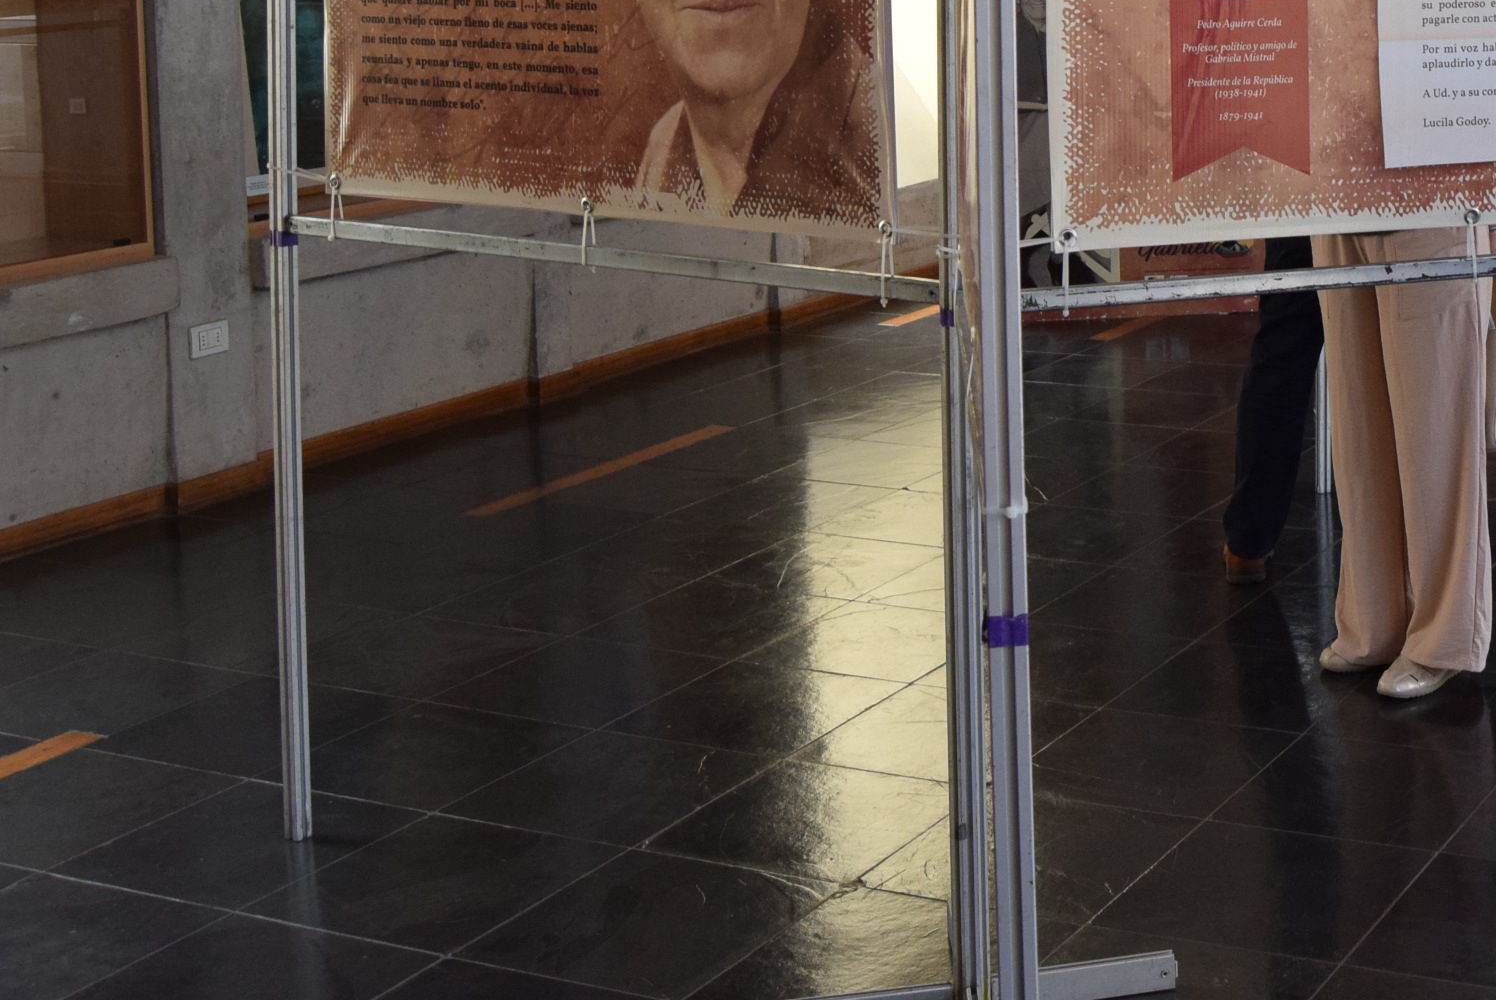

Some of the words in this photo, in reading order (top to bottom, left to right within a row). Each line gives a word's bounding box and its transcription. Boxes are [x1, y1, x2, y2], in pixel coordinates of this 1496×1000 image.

[453, 0, 470, 9] por
[545, 0, 560, 9] Me
[565, 1, 597, 11] siento
[1197, 19, 1221, 29] Pedro
[1222, 19, 1255, 30] Aguirre
[1257, 18, 1281, 26] Cerda
[1422, 14, 1460, 27] pagarle
[1183, 43, 1219, 54] Profesor,
[1220, 42, 1252, 53] político
[1260, 42, 1286, 52] amigo
[1288, 40, 1297, 48] de
[1205, 54, 1241, 62] Gabriela
[1243, 52, 1275, 61] Mistral
[1188, 78, 1230, 87] Presidente
[1232, 77, 1241, 85] de
[1243, 76, 1251, 85] la
[1253, 75, 1293, 86] República
[1215, 88, 1266, 99] (1938-1941)
[1219, 112, 1263, 121] 1879-1941
[1423, 117, 1454, 127] Lucila
[1456, 116, 1491, 127] Godoy.
